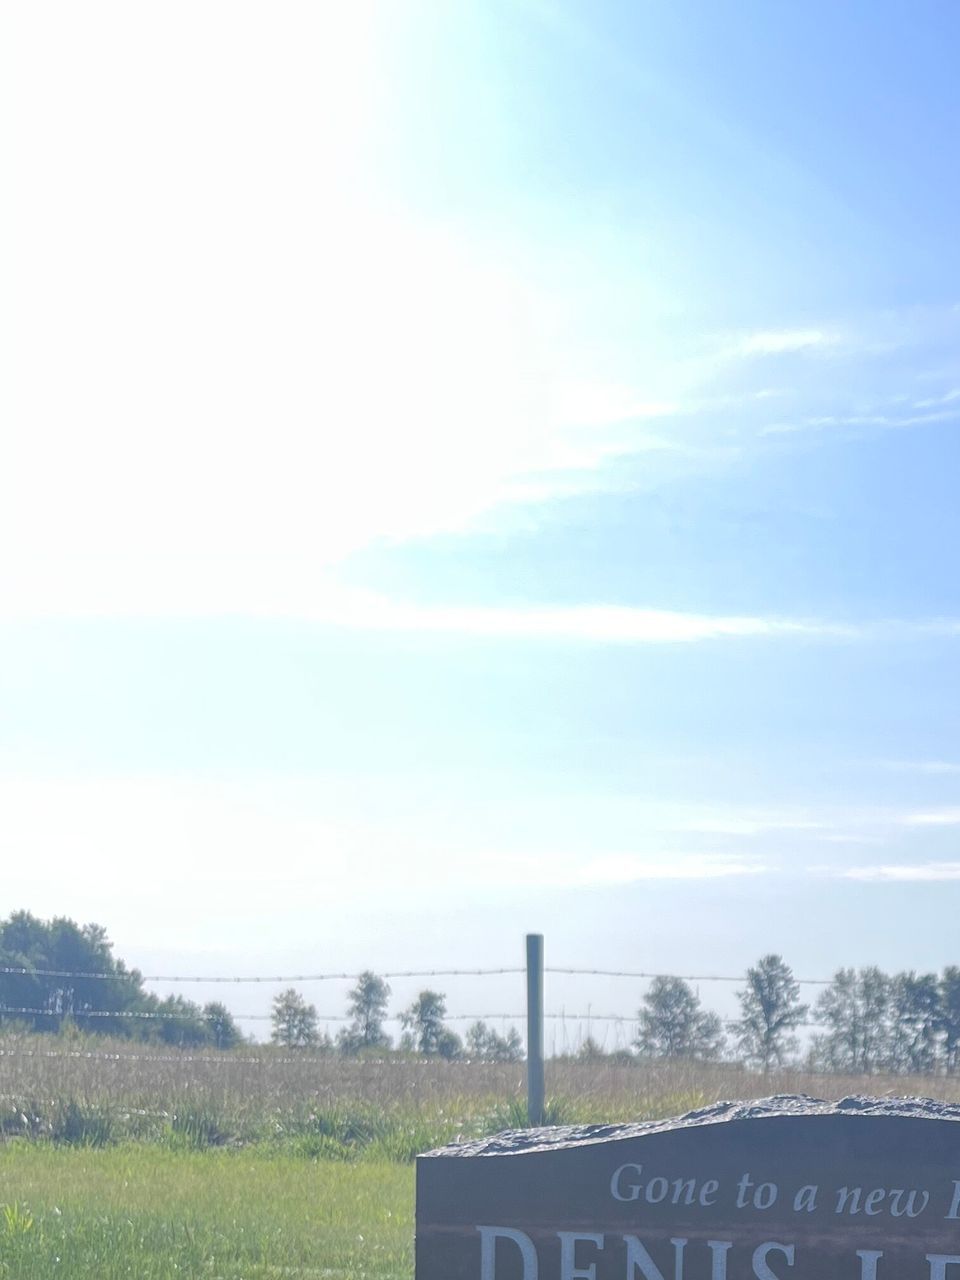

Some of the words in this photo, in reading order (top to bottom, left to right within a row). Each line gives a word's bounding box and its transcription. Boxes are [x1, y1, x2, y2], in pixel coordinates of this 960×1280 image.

[610, 1163, 719, 1206] Gone
[736, 1173, 778, 1210] to
[793, 1184, 819, 1213] a
[834, 1185, 930, 1218] new
